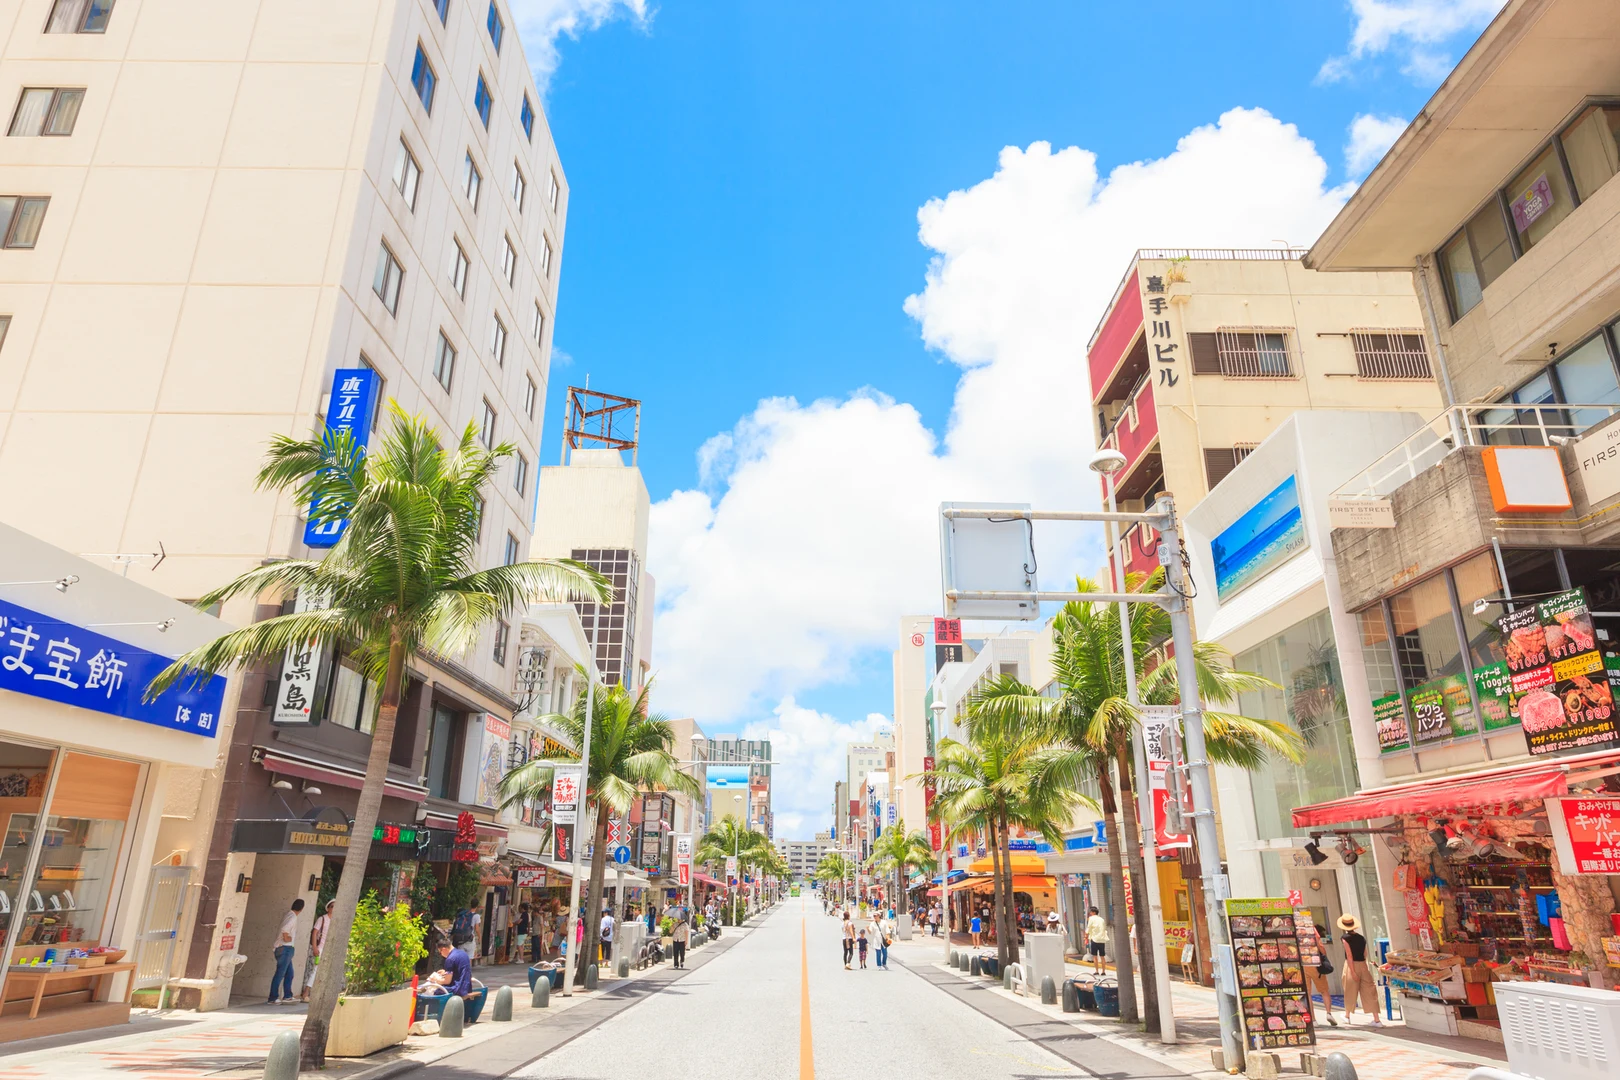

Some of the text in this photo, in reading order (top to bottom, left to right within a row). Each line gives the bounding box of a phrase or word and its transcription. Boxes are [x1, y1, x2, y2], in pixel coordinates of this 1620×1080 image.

[1523, 196, 1543, 215] YOGA
[1146, 275, 1179, 388] 嘉手川ビル
[1607, 430, 1620, 440] Ho
[1285, 536, 1305, 553] SPLASH
[1538, 588, 1581, 610] サーロインステーキ
[1510, 651, 1546, 672] ¥1000
[282, 651, 312, 710] 黒島
[1473, 666, 1501, 682] ディナーは
[1416, 701, 1441, 719] ごりら
[1569, 704, 1611, 724] ¥1980
[1574, 812, 1612, 831] キッド
[289, 831, 319, 845] HOTEL
